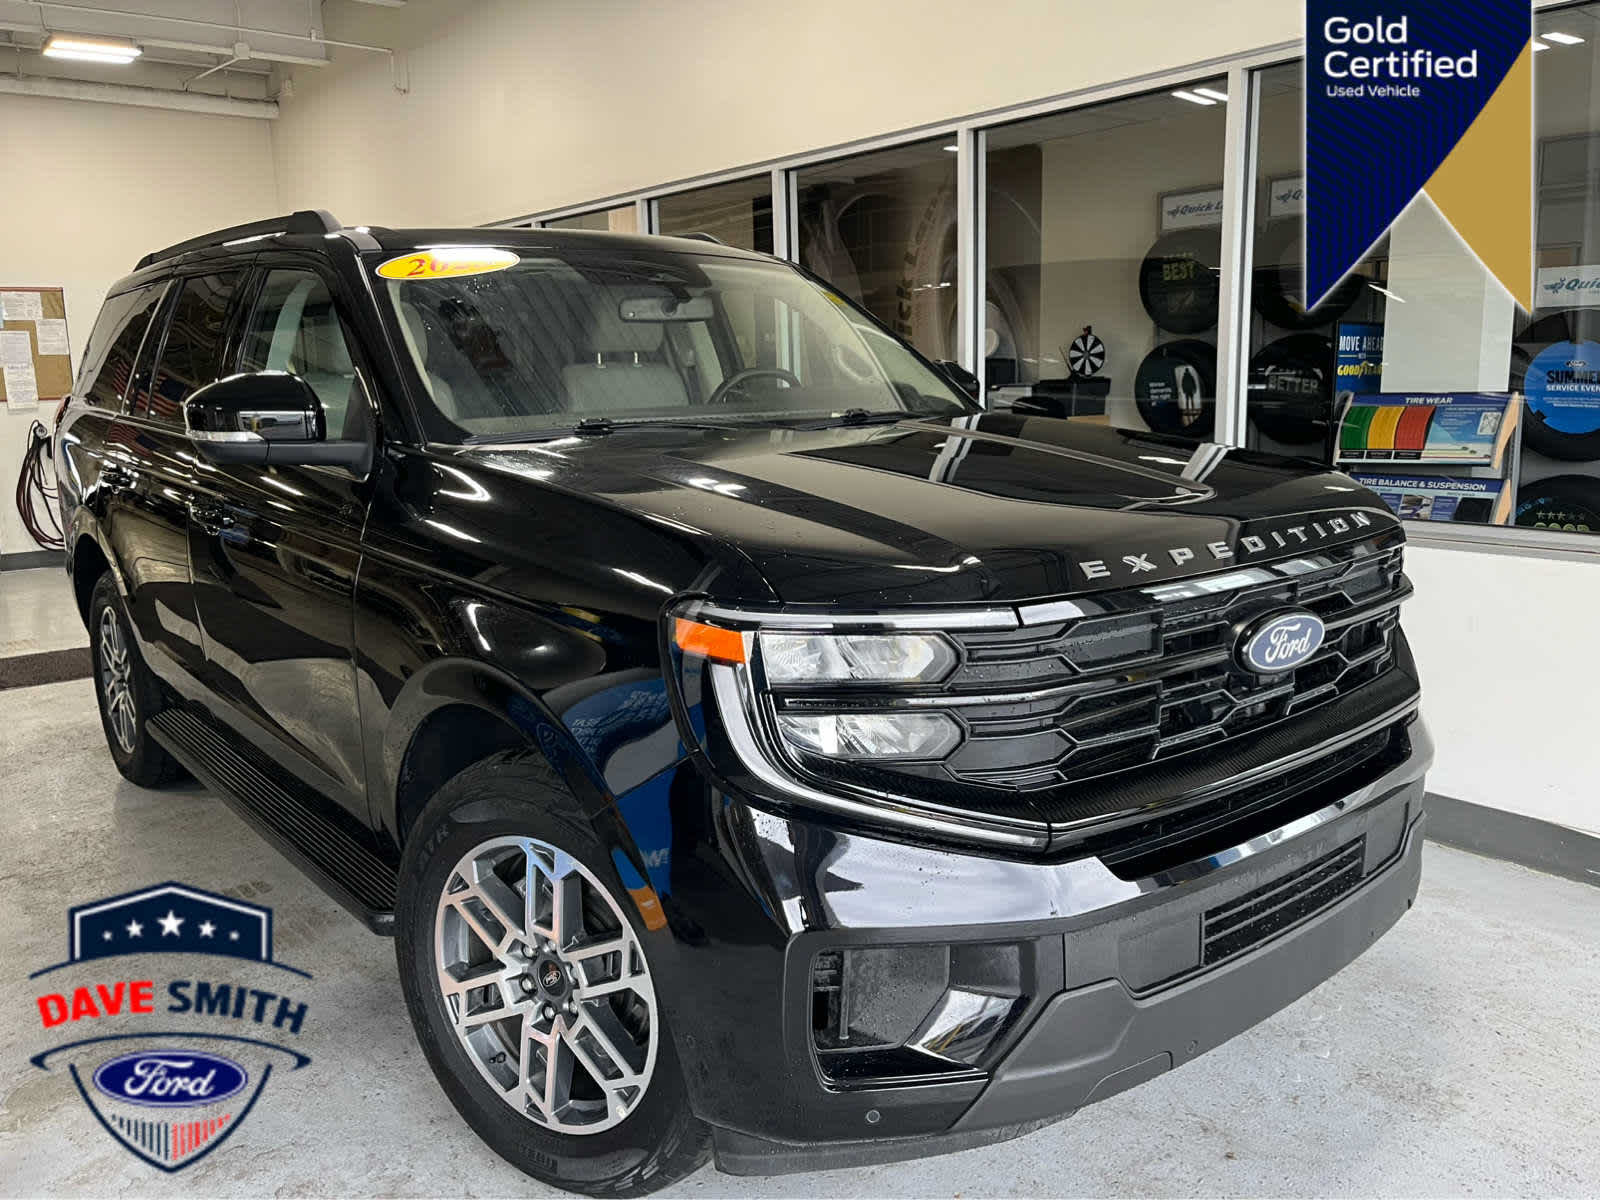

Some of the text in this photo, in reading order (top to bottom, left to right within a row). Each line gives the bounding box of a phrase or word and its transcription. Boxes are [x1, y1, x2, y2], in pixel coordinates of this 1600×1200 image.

[1339, 336, 1360, 351] MOVE
[1359, 478, 1377, 486] TIRE
[1378, 479, 1417, 488] BALANCE
[1427, 481, 1487, 491] SUSPENSION
[1078, 511, 1372, 581] EXPEDITION
